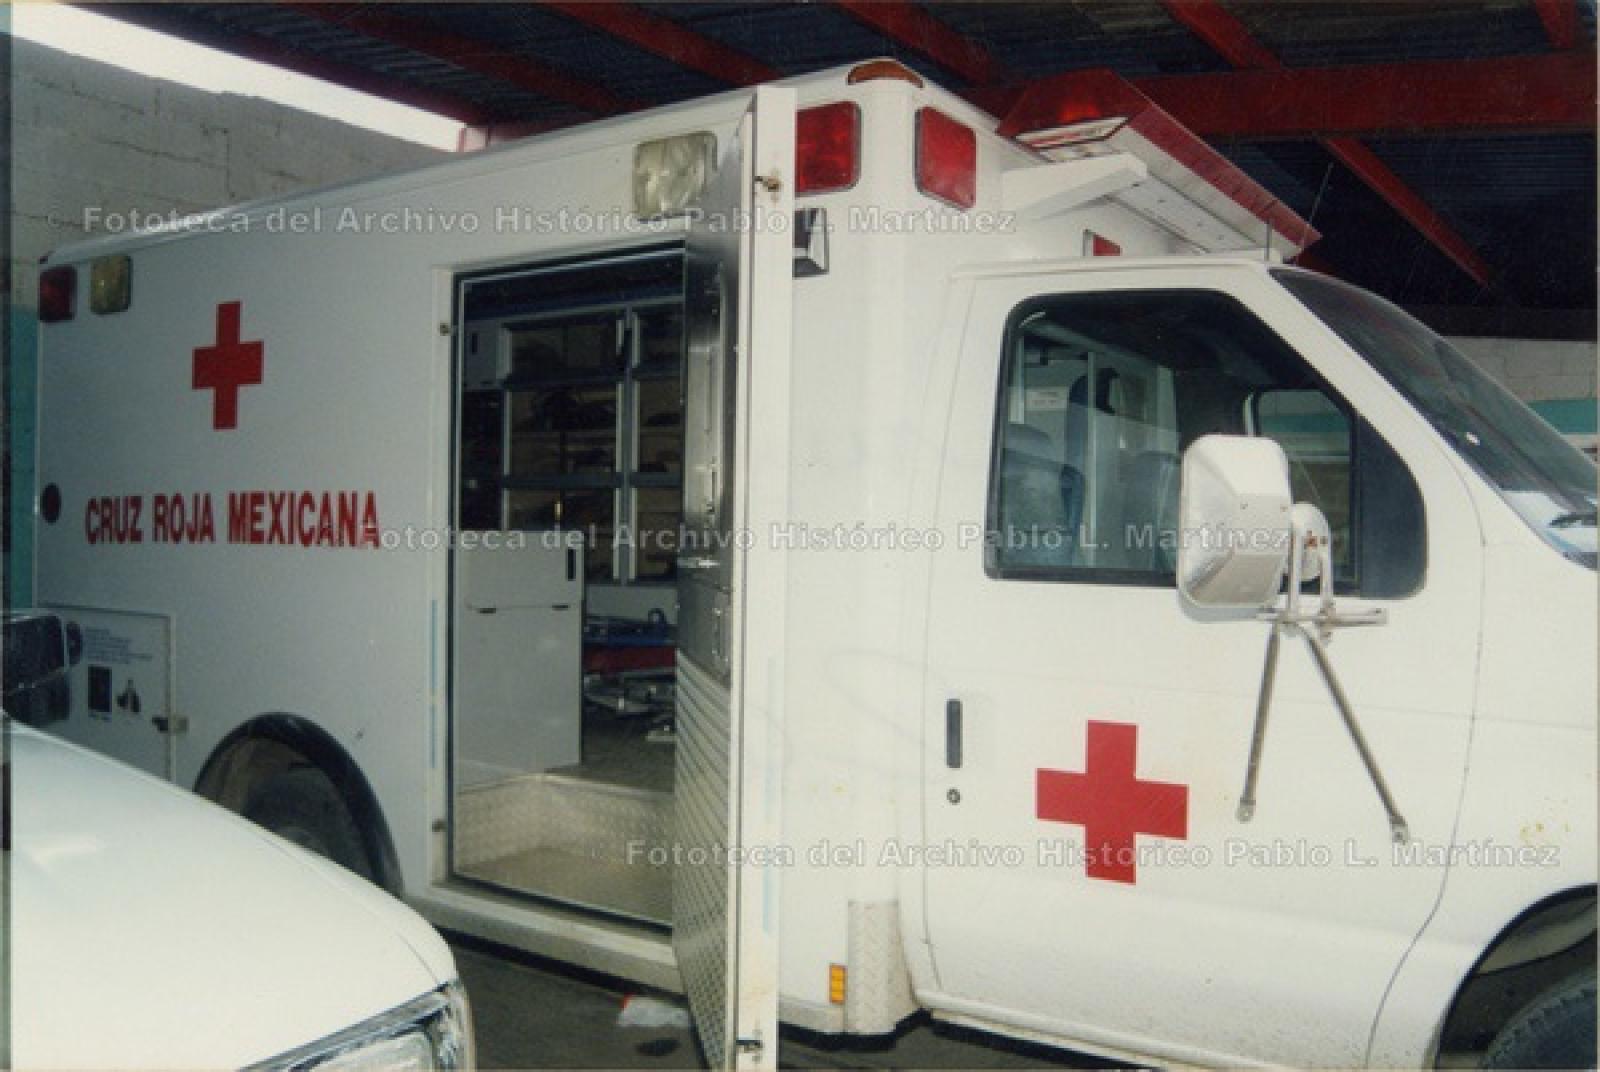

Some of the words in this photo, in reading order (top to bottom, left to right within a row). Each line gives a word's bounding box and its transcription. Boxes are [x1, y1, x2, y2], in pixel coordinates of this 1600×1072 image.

[85, 495, 144, 545] CRUZ
[154, 493, 217, 544] ROJA
[227, 490, 380, 548] MEXICANA
